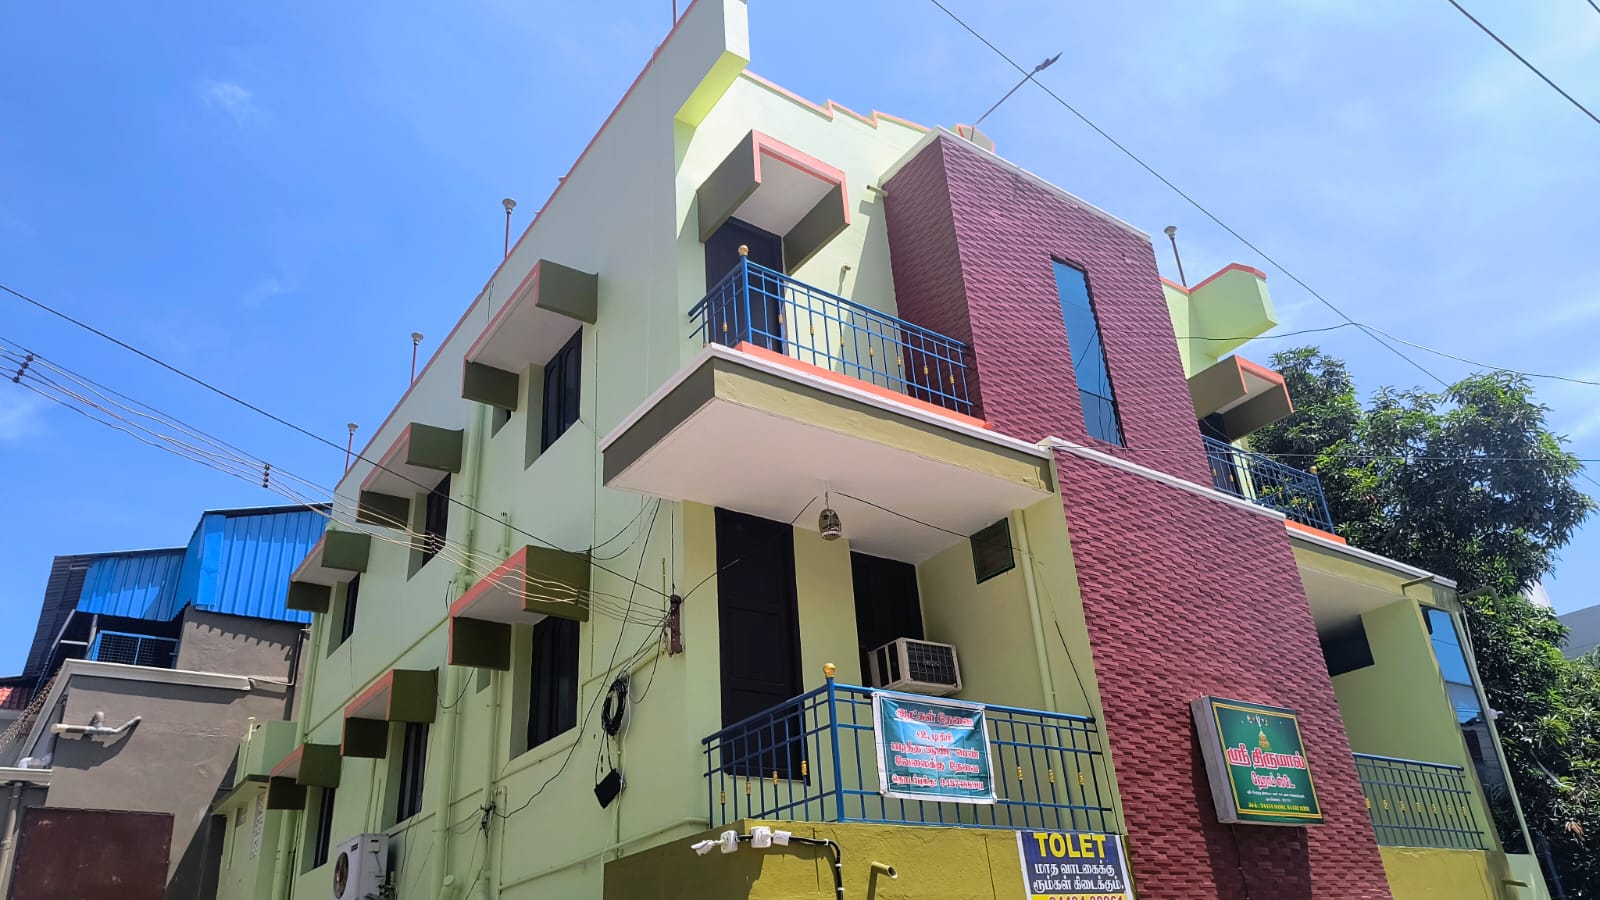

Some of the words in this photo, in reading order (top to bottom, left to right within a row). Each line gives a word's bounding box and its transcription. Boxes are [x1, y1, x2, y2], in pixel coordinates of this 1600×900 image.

[1252, 746, 1307, 769] திருமால்
[1033, 832, 1106, 858] TOLET
[1034, 863, 1058, 877] மாத
[1061, 860, 1115, 877] வாடகைக்கு
[1033, 874, 1071, 893] ரூம்கள்
